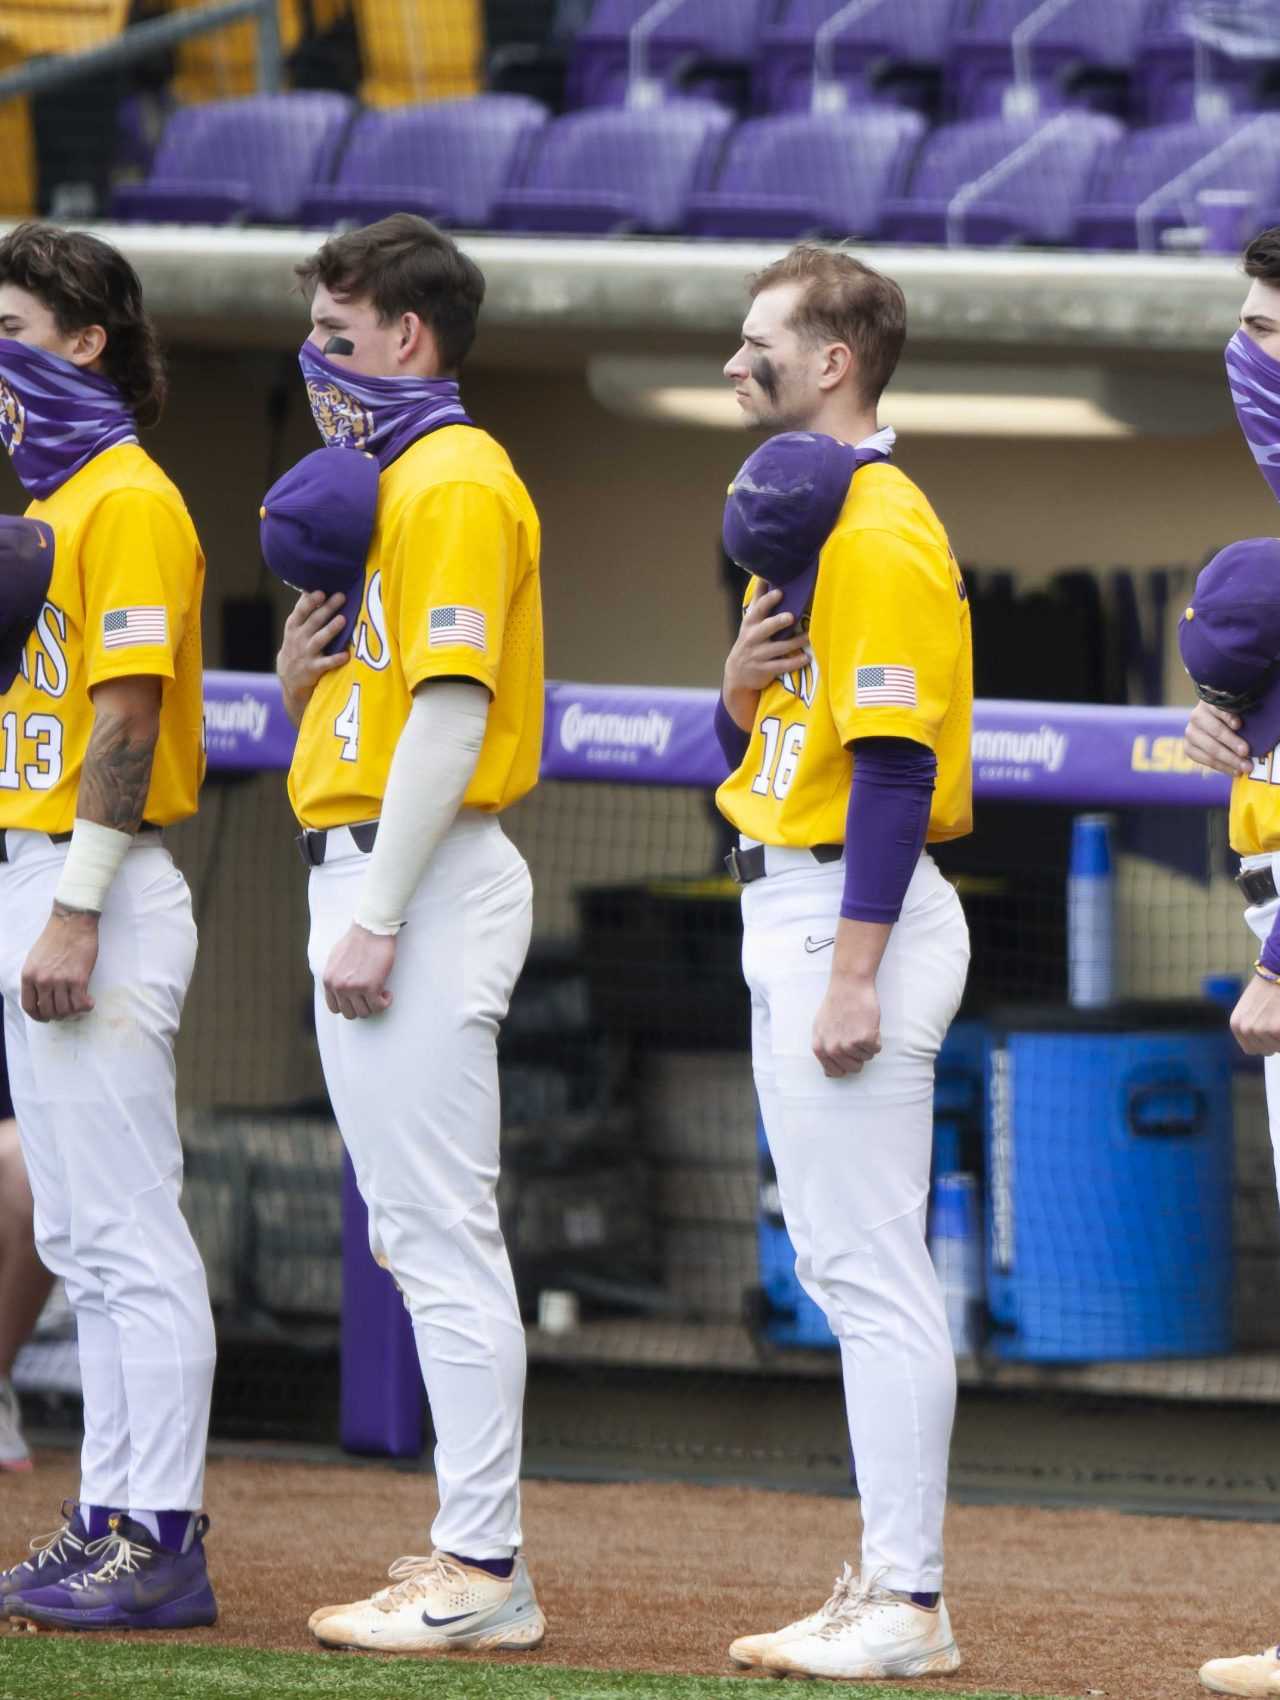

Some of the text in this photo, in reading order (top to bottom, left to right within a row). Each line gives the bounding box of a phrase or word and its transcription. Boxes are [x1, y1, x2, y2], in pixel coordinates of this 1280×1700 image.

[0, 711, 64, 790] 13
[334, 683, 361, 762] 4
[560, 702, 672, 756] Community
[751, 716, 806, 800] 16
[972, 724, 1066, 772] mmunity
